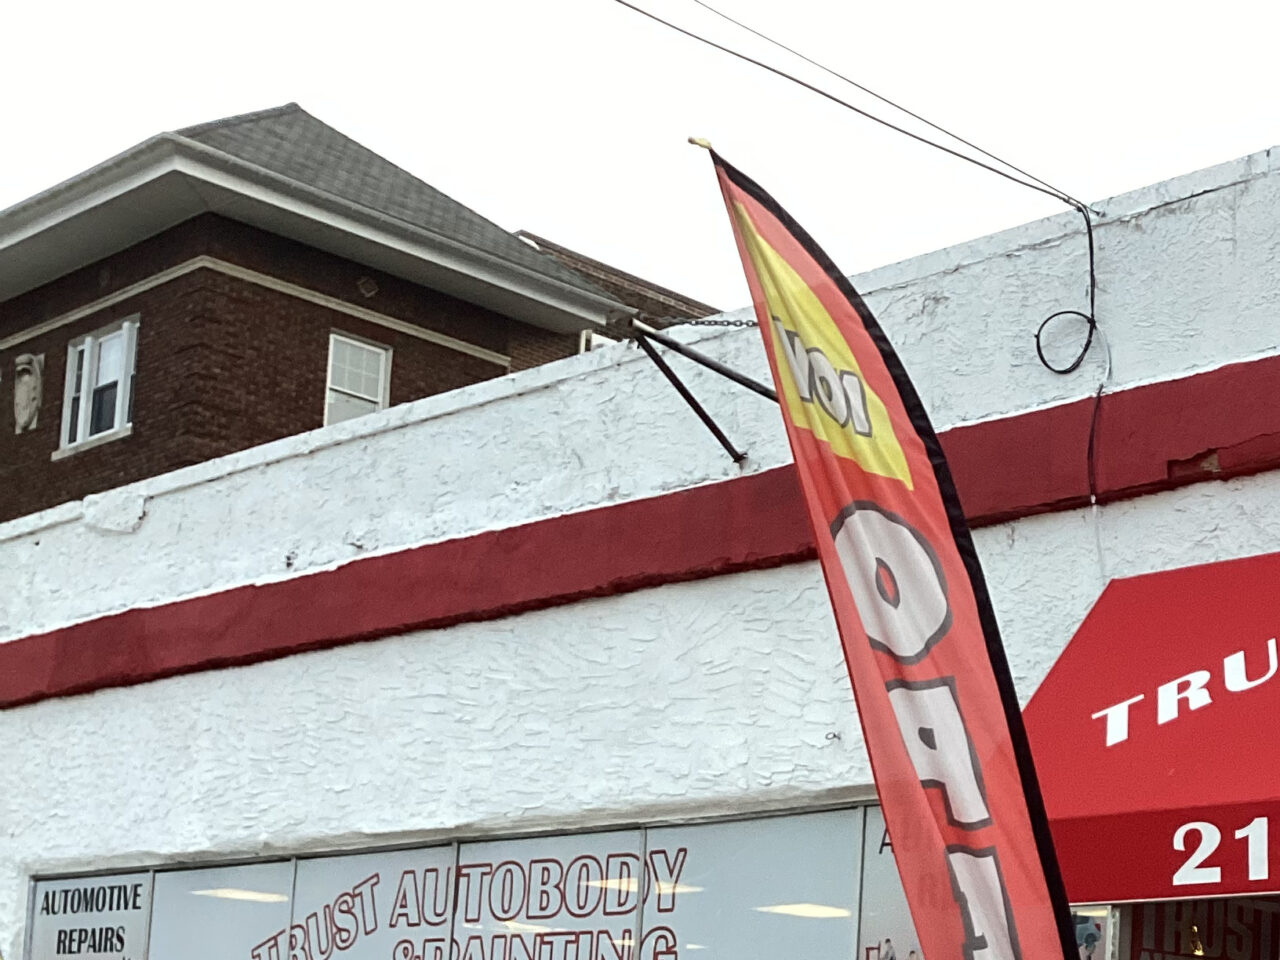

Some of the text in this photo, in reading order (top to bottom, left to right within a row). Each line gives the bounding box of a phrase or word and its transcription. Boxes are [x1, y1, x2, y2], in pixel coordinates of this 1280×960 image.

[40, 884, 143, 915] AUTOMOTIVE
[389, 848, 688, 927] AUTOBODY
[56, 927, 125, 955] REPAIRS
